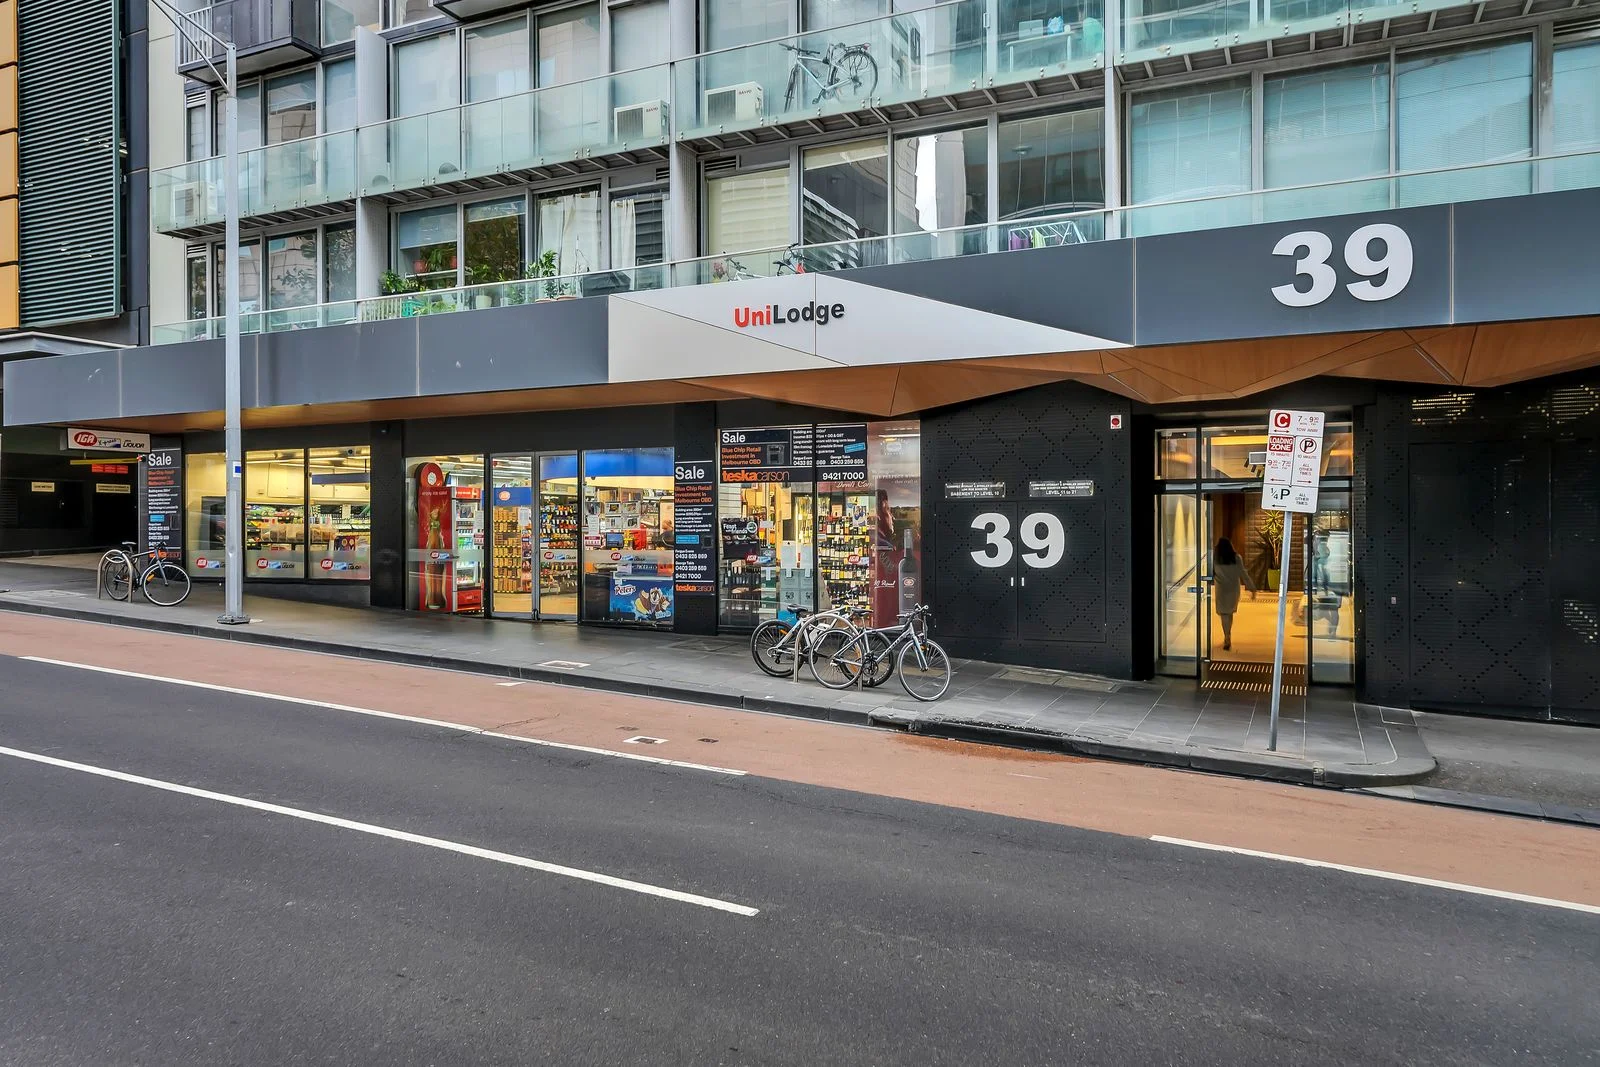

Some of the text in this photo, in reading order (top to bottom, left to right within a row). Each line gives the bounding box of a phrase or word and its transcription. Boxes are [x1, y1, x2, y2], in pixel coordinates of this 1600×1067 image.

[1271, 224, 1413, 307] 39
[734, 301, 845, 328] UniLodge
[1277, 414, 1288, 426] C
[76, 434, 95, 443] IGA
[722, 432, 746, 443] Sale
[148, 453, 172, 466] Sale
[675, 466, 704, 480] Sale
[1280, 489, 1290, 500] P
[970, 512, 1065, 568] 39
[615, 585, 636, 595] Peters
